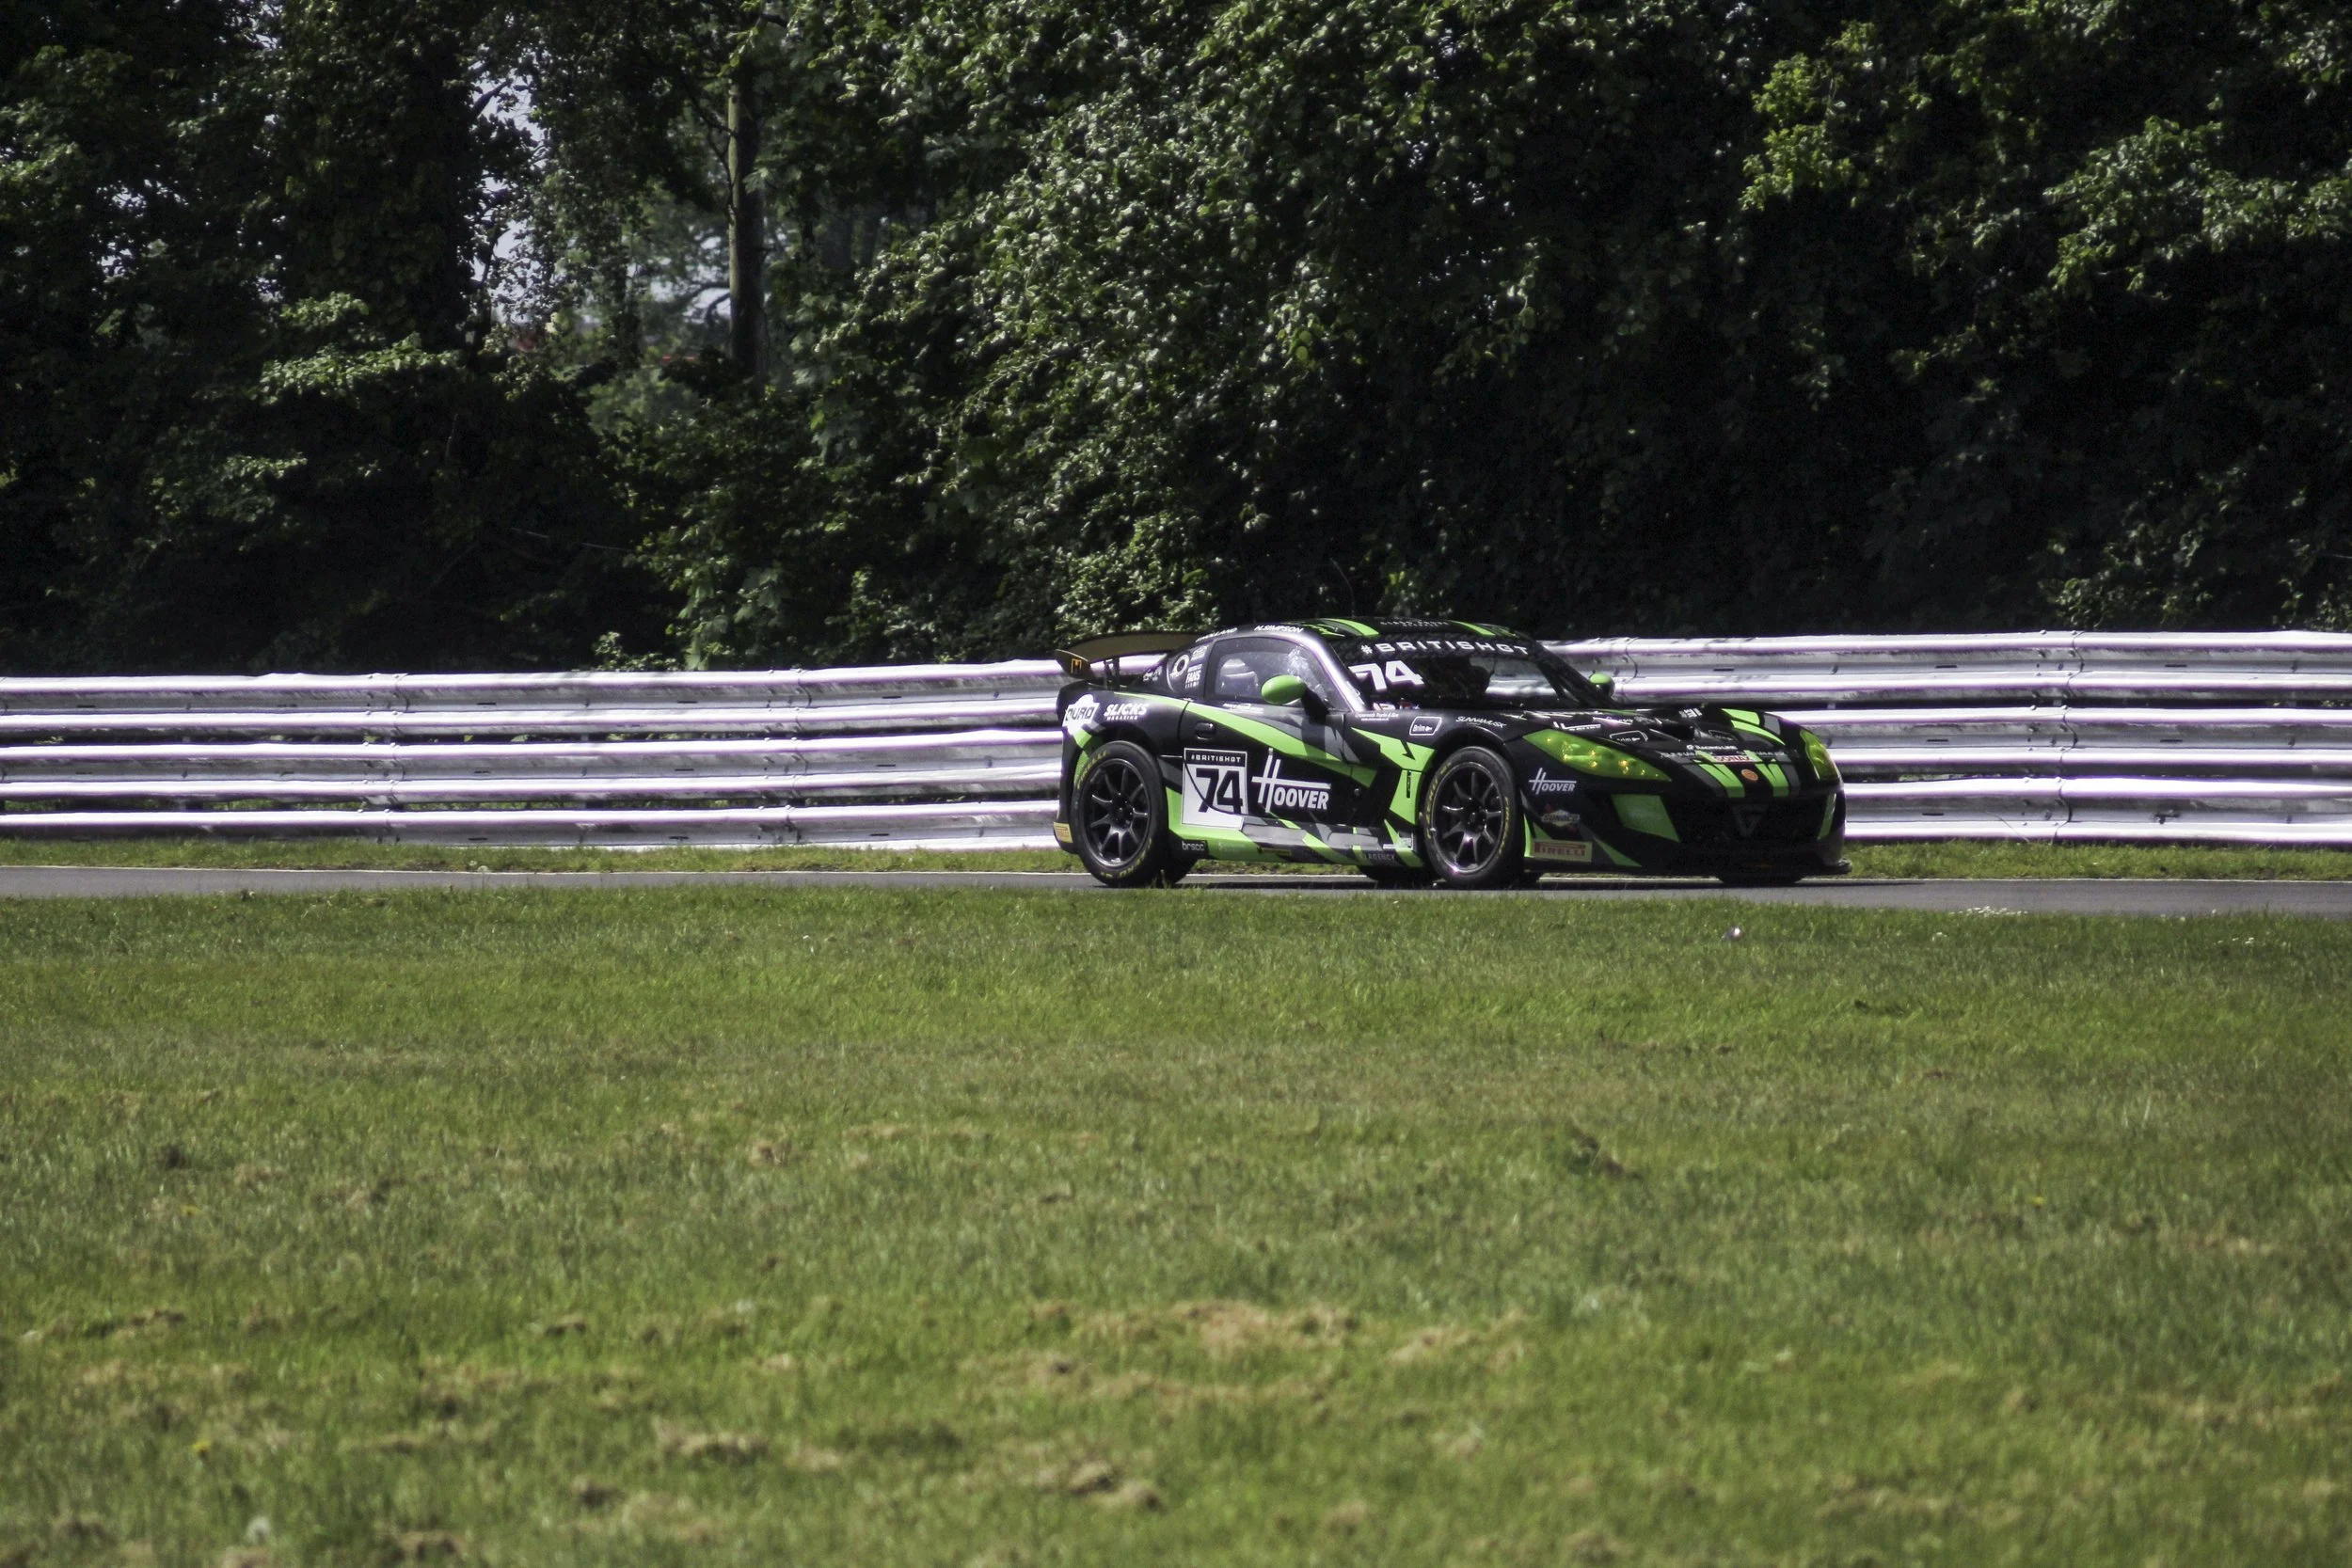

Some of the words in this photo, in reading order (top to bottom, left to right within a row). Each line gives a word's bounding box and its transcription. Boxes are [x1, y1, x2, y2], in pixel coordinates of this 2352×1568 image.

[1360, 640, 1529, 656] #BRITISHGT
[1348, 659, 1425, 691] 74
[1104, 704, 1149, 717] SLICKS
[1191, 753, 1241, 763] #BRITISHGT
[1196, 768, 1244, 815] 74
[1251, 748, 1331, 814] HOOVER
[1529, 768, 1577, 795] HOOVER
